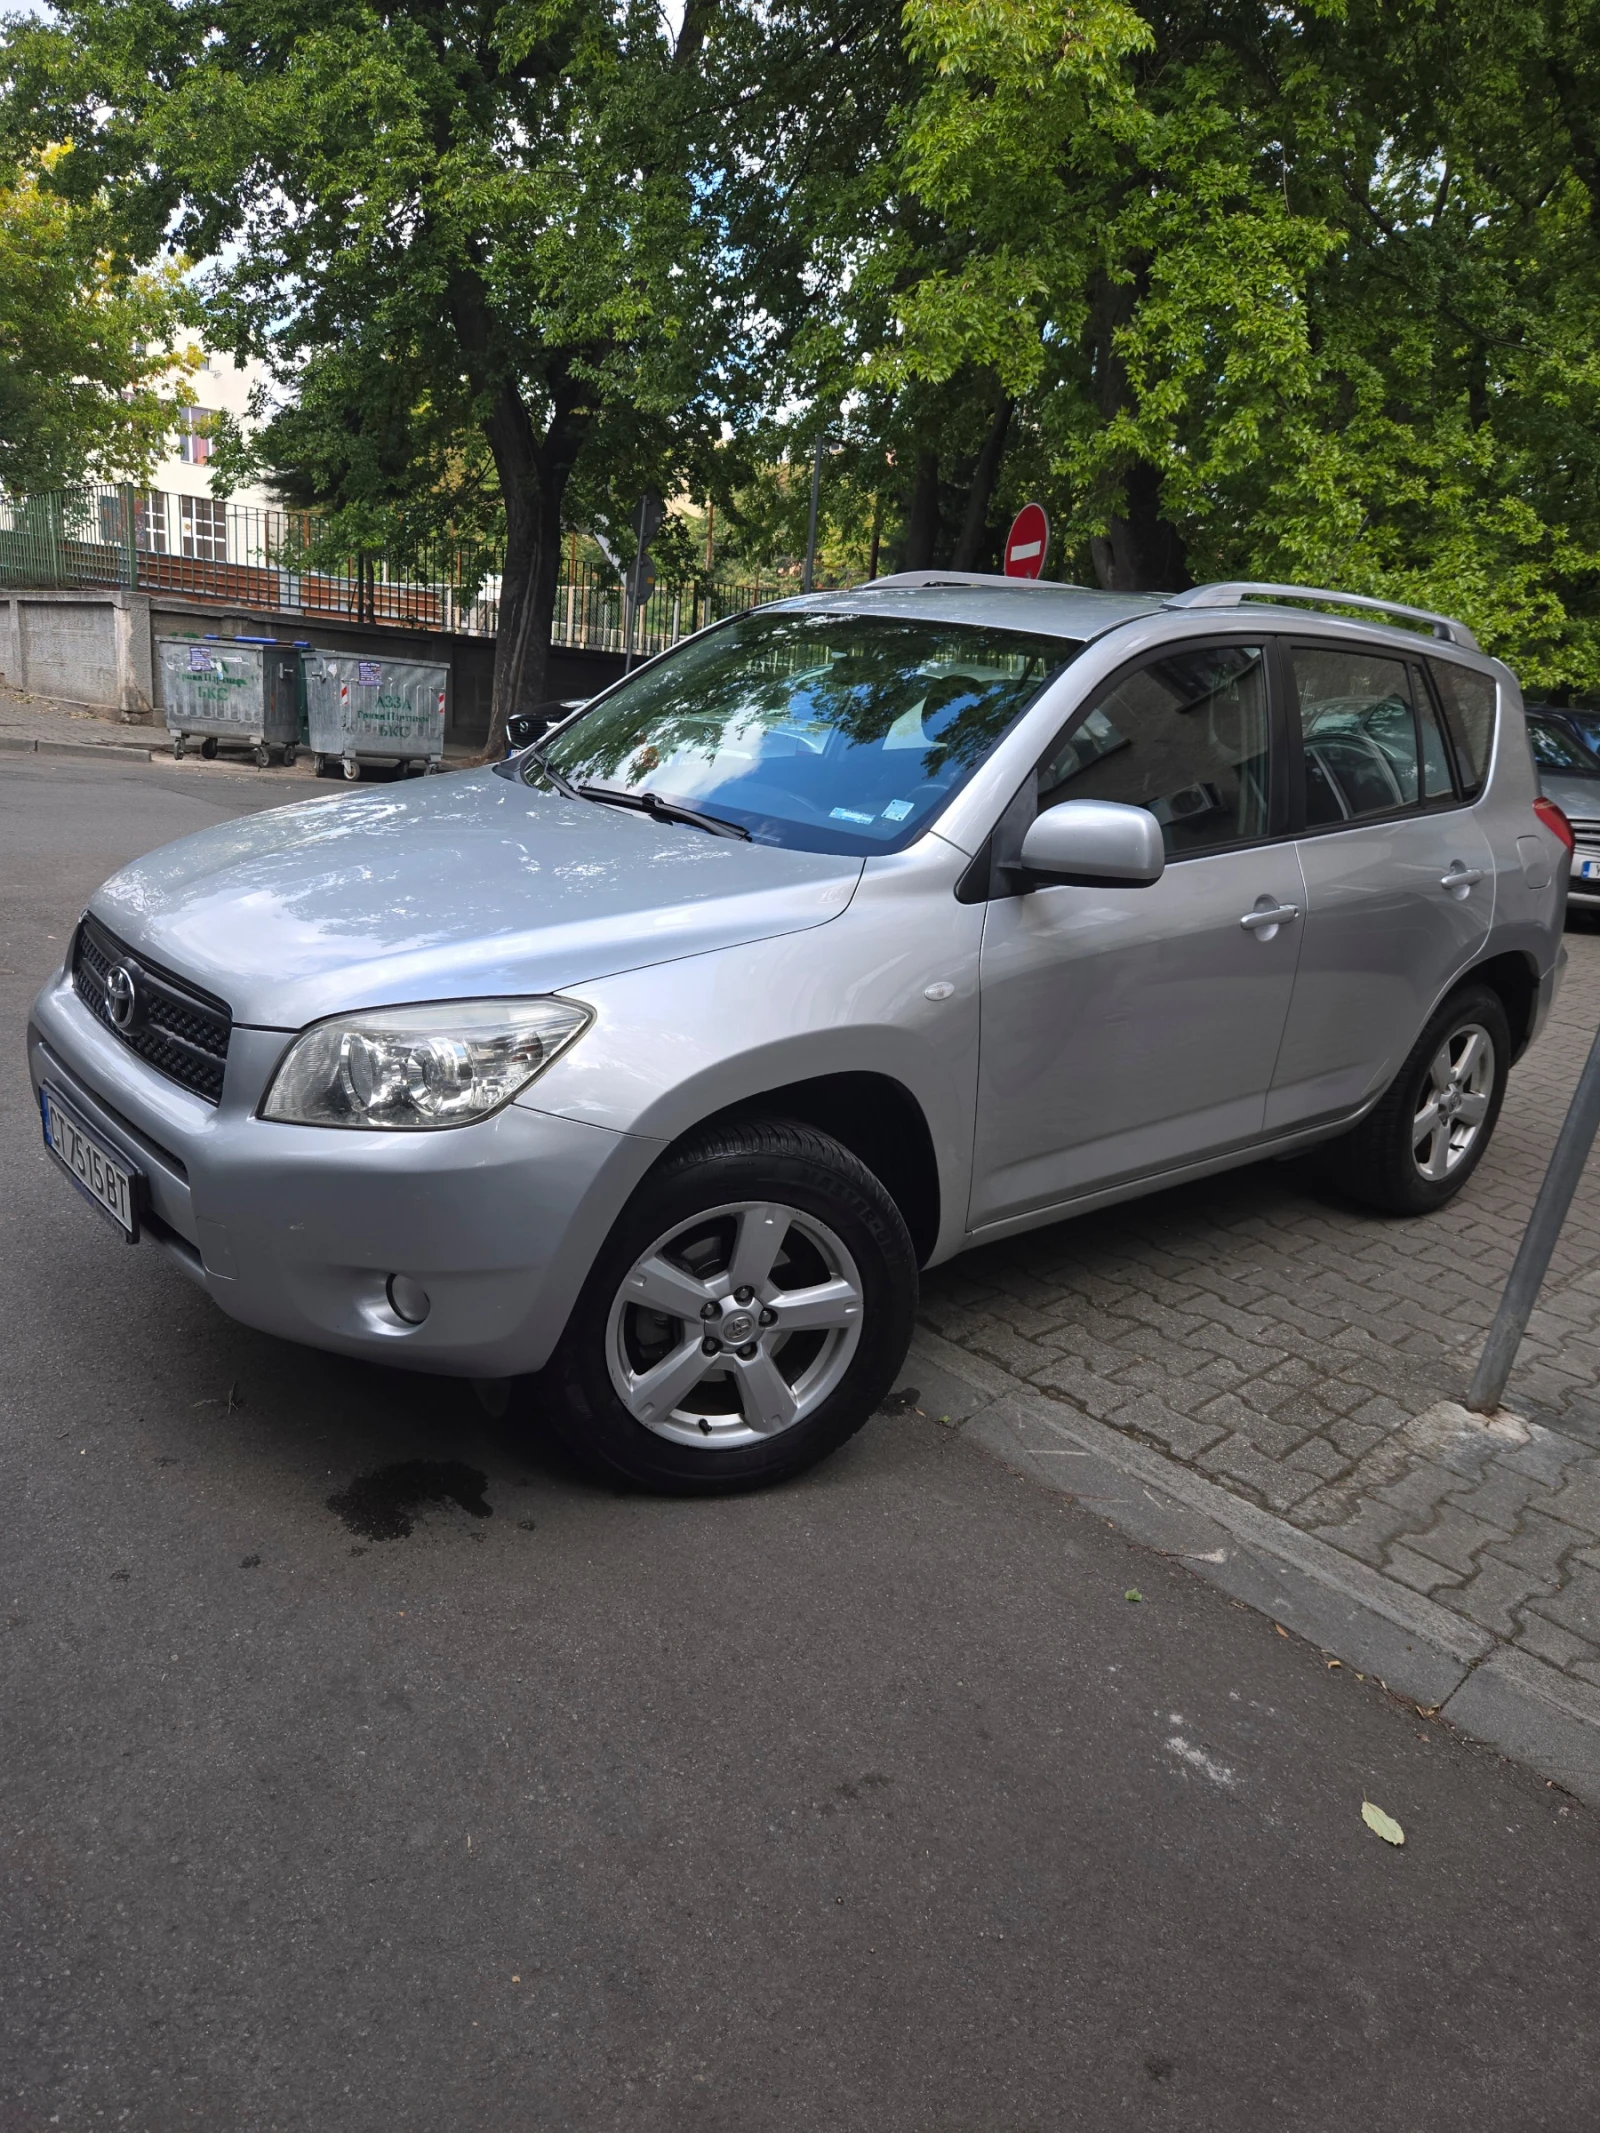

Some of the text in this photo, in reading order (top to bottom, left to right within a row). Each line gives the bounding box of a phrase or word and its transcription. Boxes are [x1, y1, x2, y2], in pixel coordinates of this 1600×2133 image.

[50, 1105, 66, 1155] CT
[67, 1124, 104, 1197] 7515
[105, 1159, 128, 1219] BT
